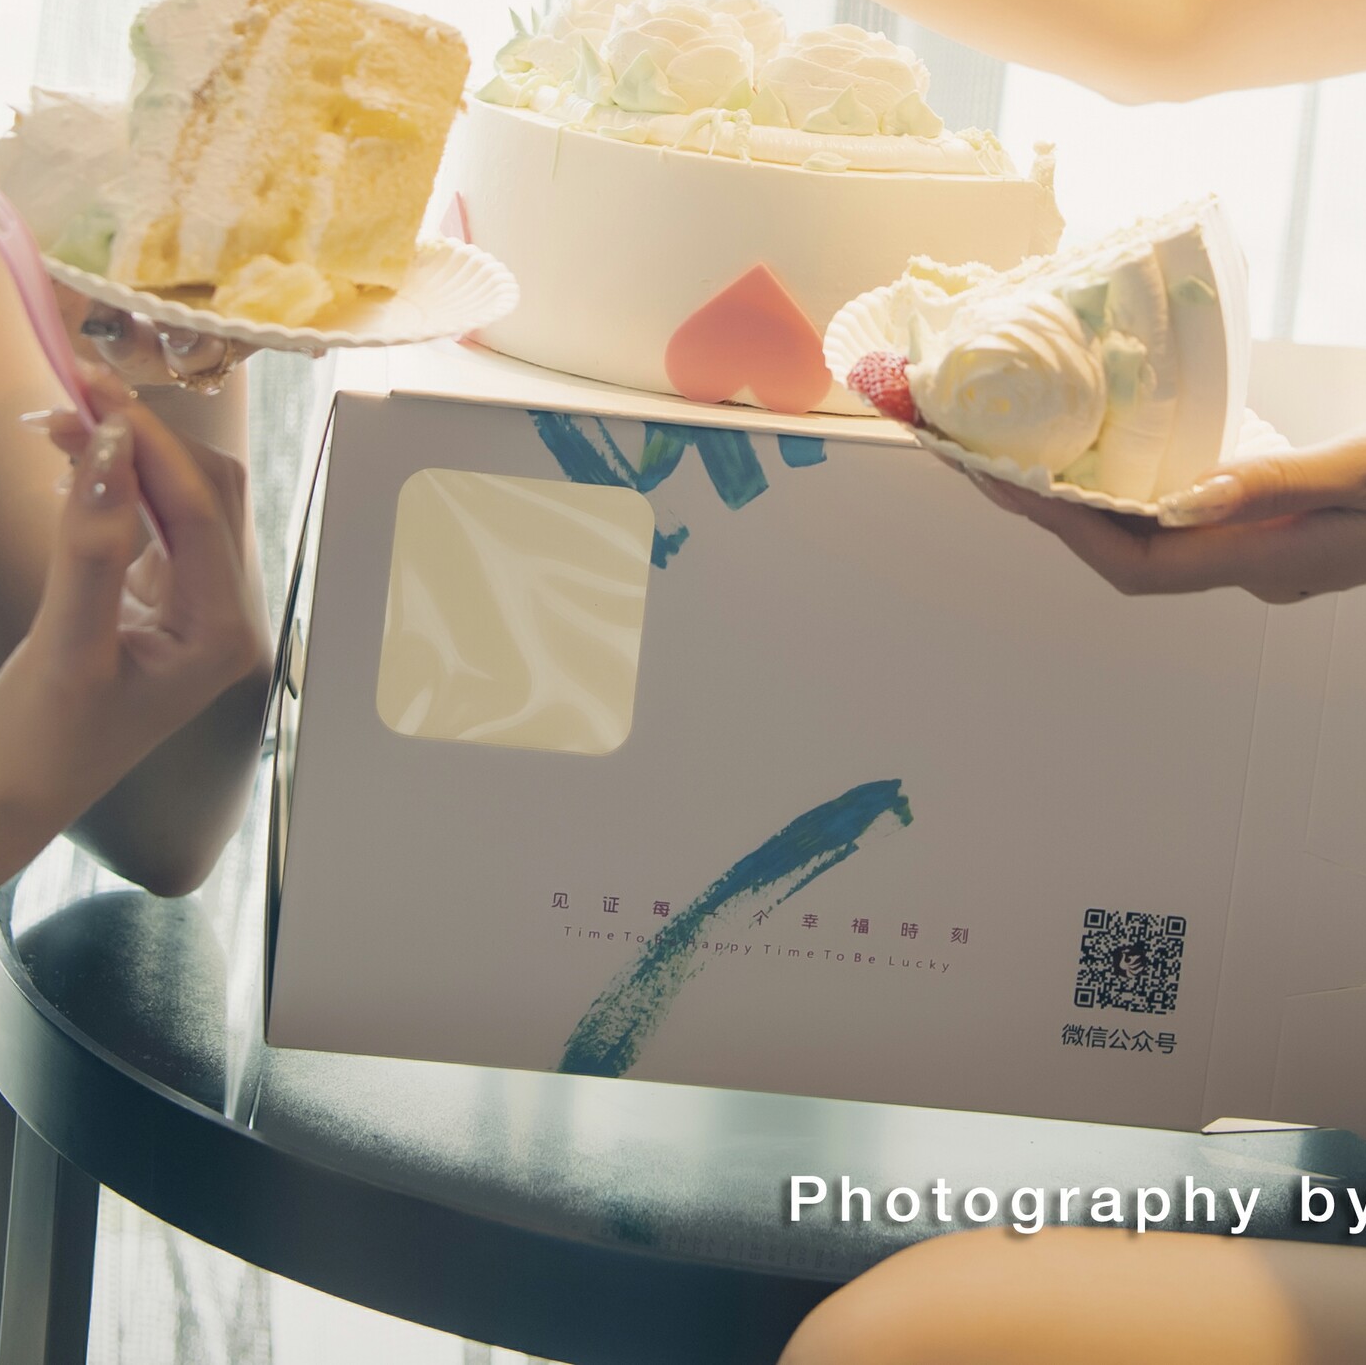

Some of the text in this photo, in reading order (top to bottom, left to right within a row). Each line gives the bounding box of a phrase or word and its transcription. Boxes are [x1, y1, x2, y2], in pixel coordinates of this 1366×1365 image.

[563, 925, 615, 941] Time
[623, 930, 645, 944] To
[763, 944, 815, 960] Time
[823, 949, 845, 963] To
[853, 952, 876, 965] Be
[888, 955, 951, 973] Lucky
[1061, 1023, 1178, 1055] 微信公众号
